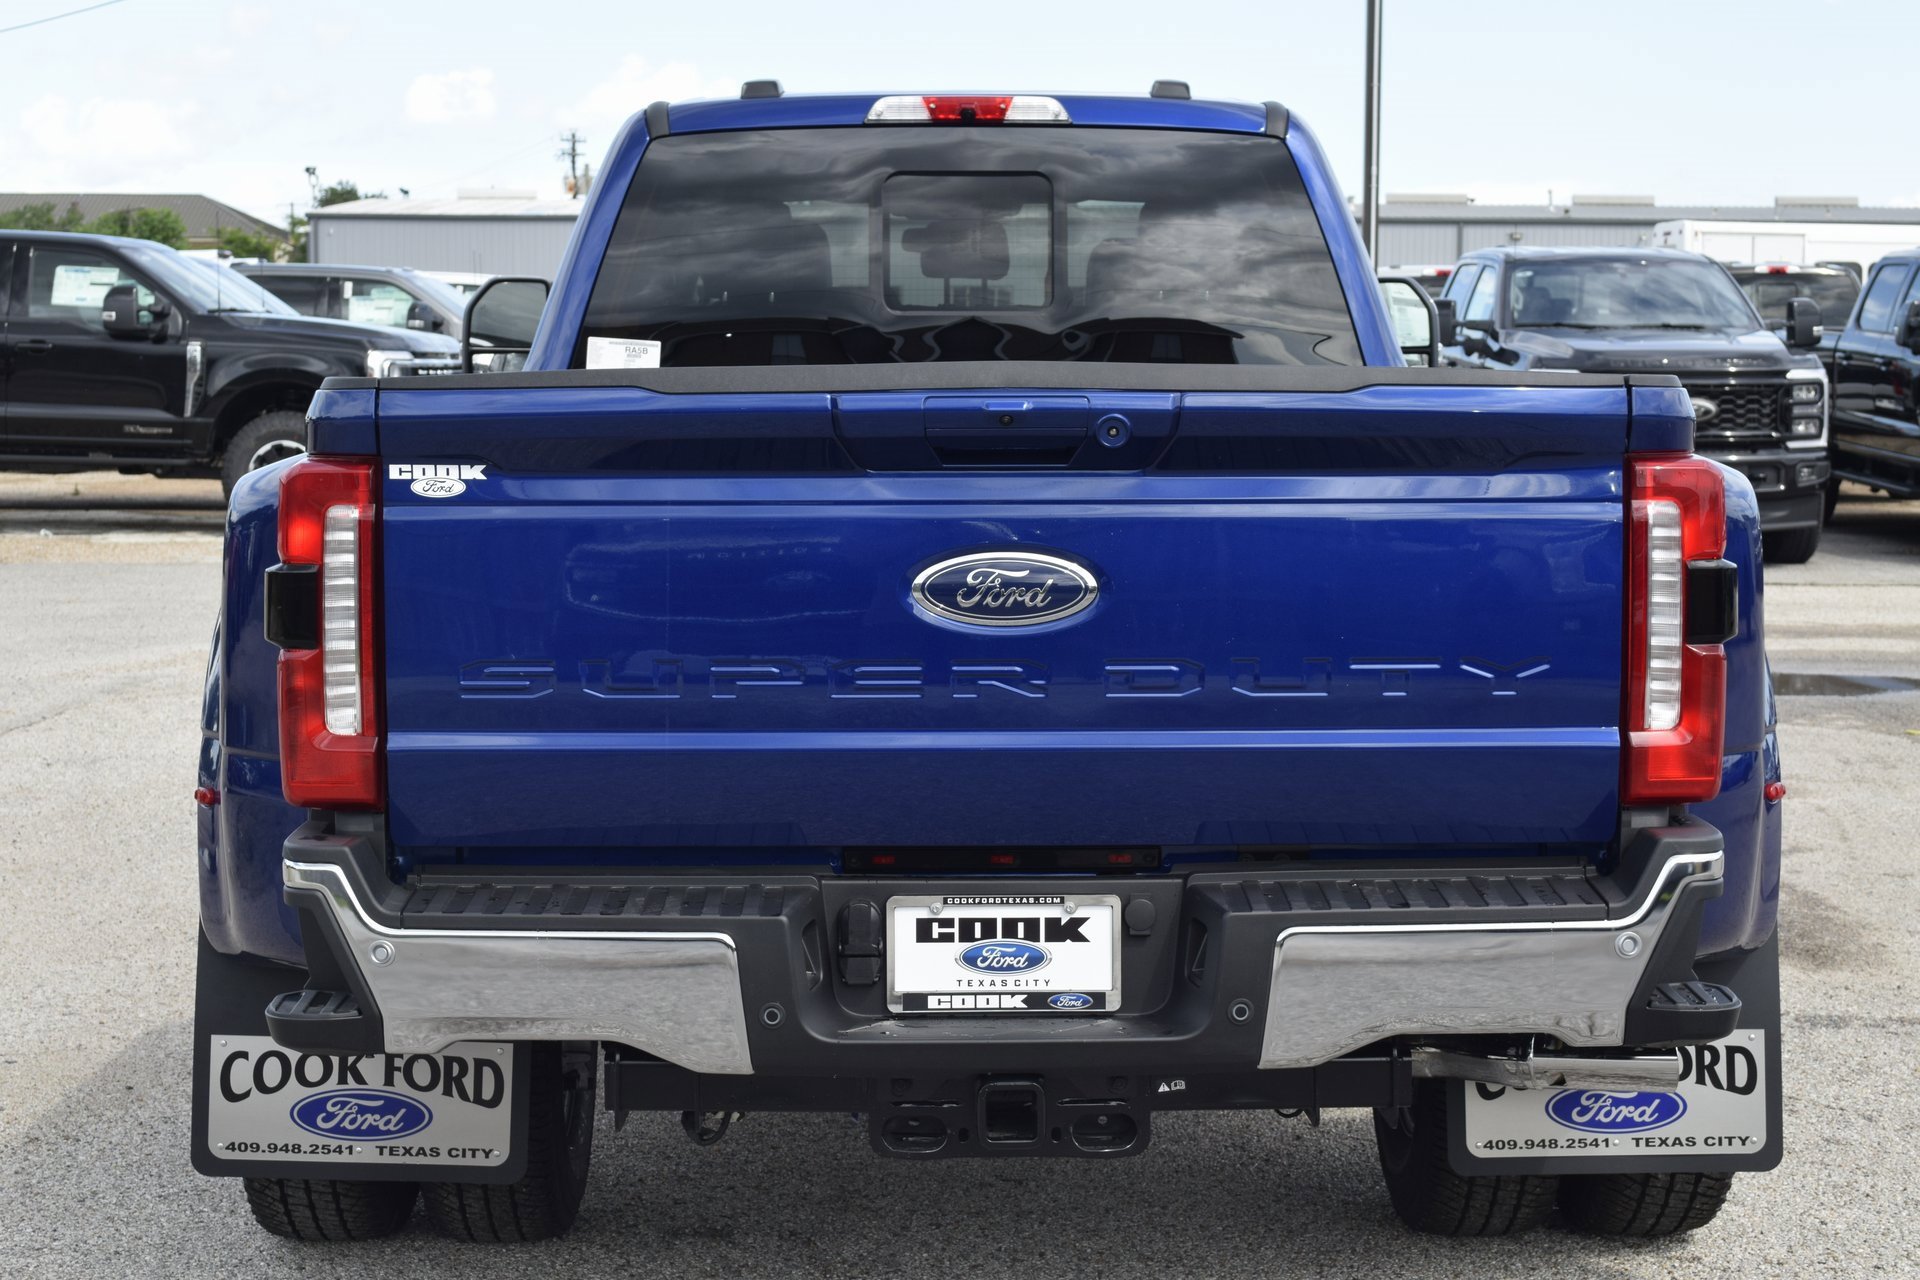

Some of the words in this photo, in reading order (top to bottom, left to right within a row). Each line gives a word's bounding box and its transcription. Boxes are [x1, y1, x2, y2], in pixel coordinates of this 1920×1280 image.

[389, 464, 487, 479] COOK
[422, 480, 454, 493] Ford
[956, 568, 1054, 608] Ford
[459, 659, 1048, 698] SUPER
[1104, 656, 1552, 697] DUTY
[916, 917, 1091, 943] COOK
[976, 946, 1028, 968] Ford
[956, 979, 1008, 987] TEXAS
[1014, 979, 1051, 987] CITY
[927, 995, 1028, 1009] COOK
[1057, 995, 1083, 1007] Ford
[219, 1050, 377, 1102] COOK
[383, 1052, 505, 1109] FORD
[316, 1097, 404, 1131] Ford
[1571, 1090, 1659, 1123] Ford
[224, 1142, 354, 1155] 409.948.2541
[376, 1145, 440, 1158] TEXAS
[447, 1147, 494, 1159] CITY
[1483, 1137, 1610, 1150] 409.948.2541
[1632, 1136, 1697, 1148] TEXAS
[1703, 1136, 1750, 1147] CITY
